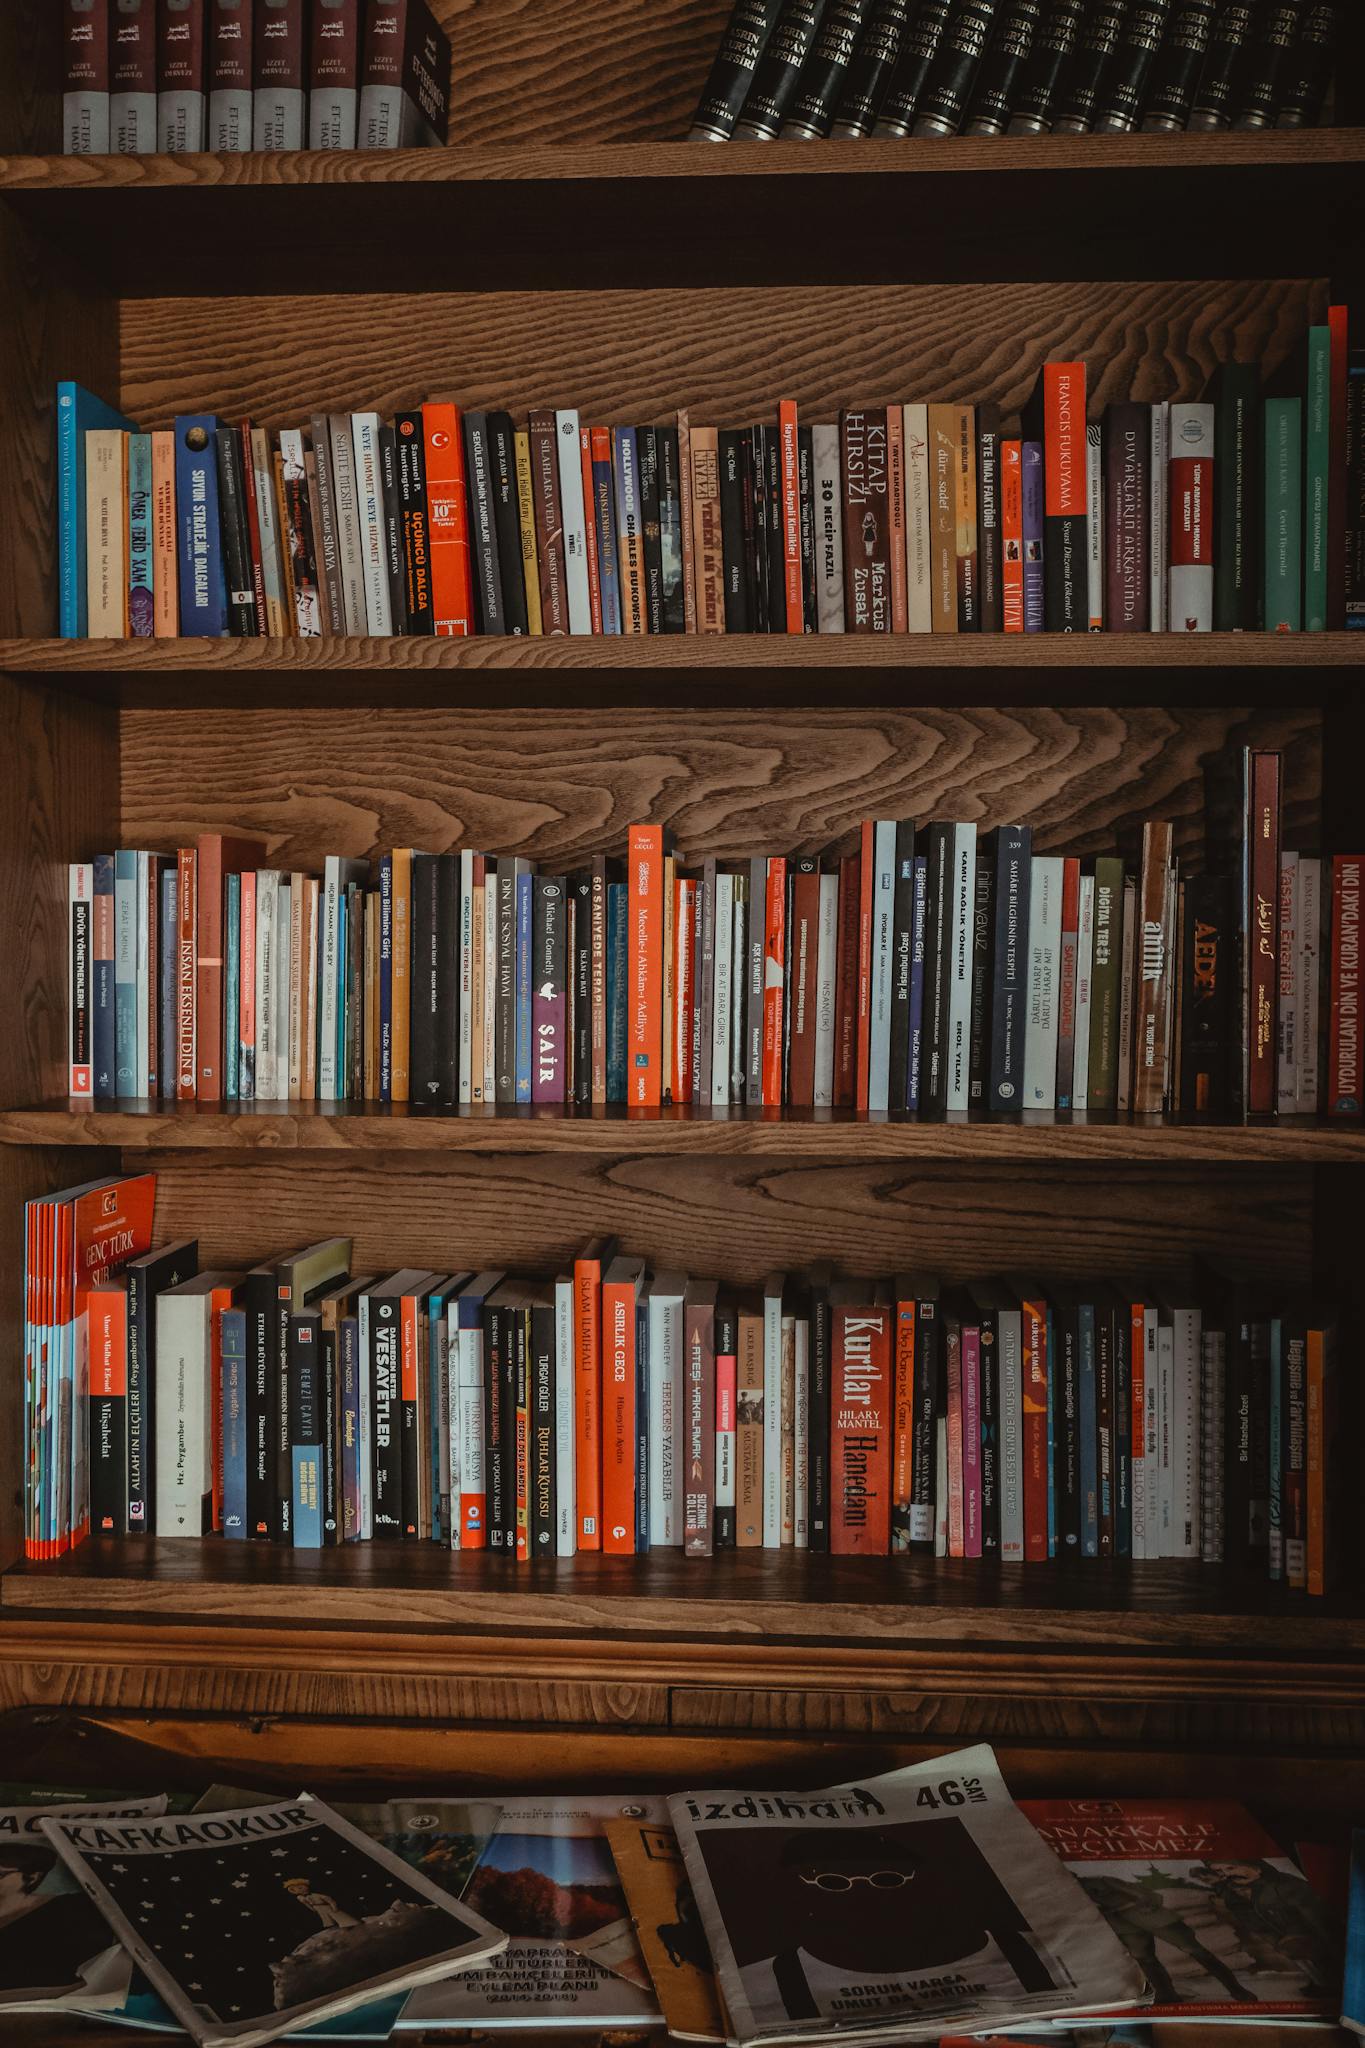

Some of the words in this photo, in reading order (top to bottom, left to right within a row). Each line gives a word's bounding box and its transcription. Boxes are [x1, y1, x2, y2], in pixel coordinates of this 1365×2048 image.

[1058, 376, 1071, 431] FRANCIS
[362, 426, 372, 451] NEYE
[473, 431, 483, 467] SEKÜLER
[364, 453, 375, 495] HİMMET
[399, 445, 411, 499] Huntington
[411, 444, 419, 481] Samuel
[541, 440, 553, 499] SİLAHLARA
[622, 439, 634, 511] HOLLYWOOD
[1060, 435, 1071, 508] FUKUYAMA
[192, 470, 206, 501] SUYUN
[476, 469, 487, 499] BİLİMİN
[367, 498, 376, 522] NEYE
[478, 501, 490, 542] TANRILARI
[545, 503, 556, 531] VEDA
[786, 490, 796, 516] Hayali
[194, 505, 210, 554] STRATEJİK
[412, 512, 425, 564] ÜÇÜNCÜ
[627, 515, 637, 567] CHARLES
[702, 502, 714, 549] YEMEN!
[788, 518, 798, 555] Kimlikler
[369, 526, 379, 563] HİZMET
[548, 548, 557, 574] ERNEST
[1064, 546, 1072, 579] Düzenin
[195, 558, 208, 607] DALGALARI
[484, 548, 492, 581] FURKAN
[416, 568, 427, 609] DALGA
[550, 578, 560, 624] HEMINGWAY
[630, 571, 640, 633] BUKOWSKI
[704, 576, 715, 624] YEMEN!
[854, 568, 867, 624] Zusak
[872, 562, 884, 630] Markus
[1064, 581, 1072, 619] Kökenleri
[381, 867, 390, 897] Eğitim
[501, 879, 512, 899] DİN
[916, 867, 925, 898] Eğitim
[1337, 864, 1360, 886] DİN
[77, 907, 85, 936] BÜYÜK
[382, 899, 392, 936] Bilimine
[502, 905, 511, 918] VE
[546, 903, 555, 934] Michael
[593, 896, 603, 957] SANİYEDE
[916, 901, 925, 938] Bilimine
[381, 938, 391, 959] Giriş
[501, 922, 511, 960] SOSYAL
[543, 938, 555, 975] Connelly
[914, 941, 924, 962] Giriş
[77, 938, 87, 1008] YÖNETMENLERİN
[182, 940, 194, 980] İNSAN
[501, 965, 510, 997] HAYAT
[593, 962, 602, 1006] TERAPİ
[1341, 972, 1358, 987] VE
[182, 986, 193, 1039] EKSENLİ
[182, 1042, 194, 1068] DİN
[1338, 1019, 1356, 1093] UYDURULAN
[614, 1301, 625, 1347] ASIRLIK
[663, 1307, 671, 1323] ANN
[538, 1355, 548, 1381] TURGAY
[615, 1351, 625, 1381] GECE
[842, 1317, 882, 1404] Kurtlar
[300, 1369, 313, 1400] REMZİ
[376, 1328, 389, 1447] VESAYETLER
[538, 1384, 549, 1411] GÜLER
[298, 1405, 313, 1436] ÇAYIR
[662, 1381, 673, 1432] HERKES
[692, 1387, 702, 1460] YAKALAMAK
[839, 1411, 880, 1419] HILARY
[538, 1427, 550, 1473] RUHLAR
[743, 1431, 751, 1472] MUSTAFA
[537, 1475, 550, 1517] KUYUSU
[743, 1474, 751, 1504] KEMAL
[842, 1436, 877, 1526] Hanedanı
[687, 1494, 697, 1529] COLLINS
[697, 1494, 707, 1529] SUZANNE
[686, 1792, 885, 1821] izdiham
[916, 1780, 966, 1809] 46
[62, 1805, 318, 1850] KAFKAOKUR
[831, 1998, 883, 2010] UMUT
[886, 1992, 911, 2005] DA
[915, 1984, 987, 2000] VARDIR
[840, 1983, 904, 1997] SORUN
[908, 1975, 967, 1991] VARSA
